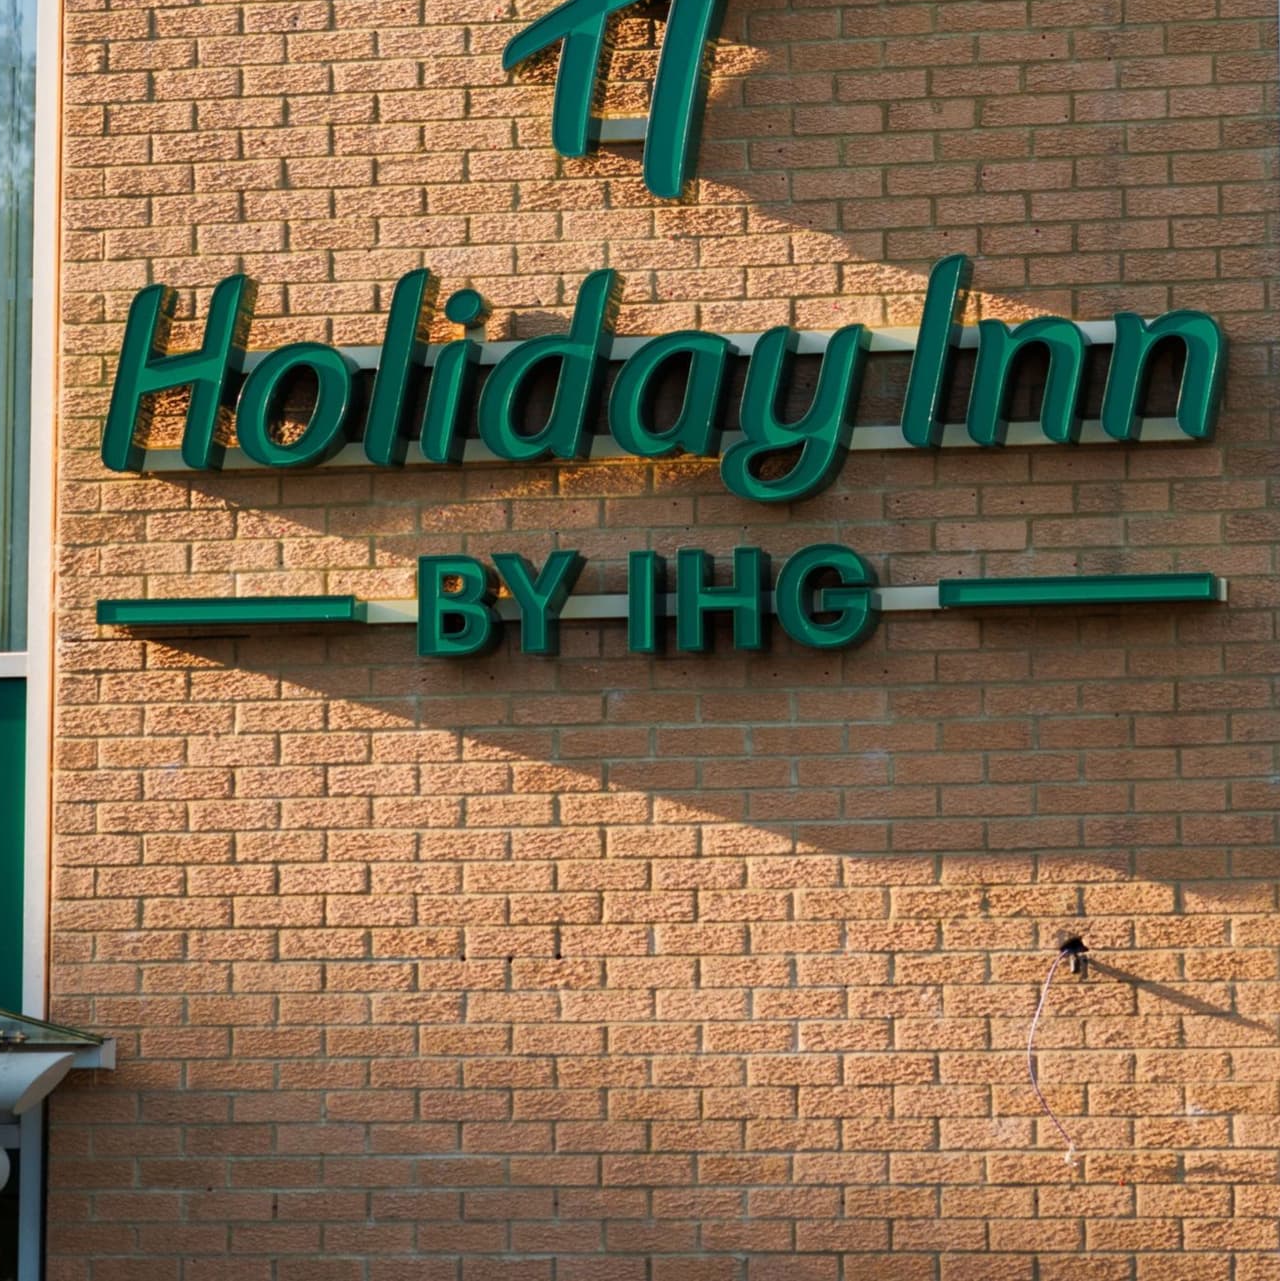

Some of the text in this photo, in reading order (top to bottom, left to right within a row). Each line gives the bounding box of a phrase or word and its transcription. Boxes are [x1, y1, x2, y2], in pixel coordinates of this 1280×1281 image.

[101, 254, 1228, 503] Holiday Inn
[416, 542, 881, 659] BY IHG
